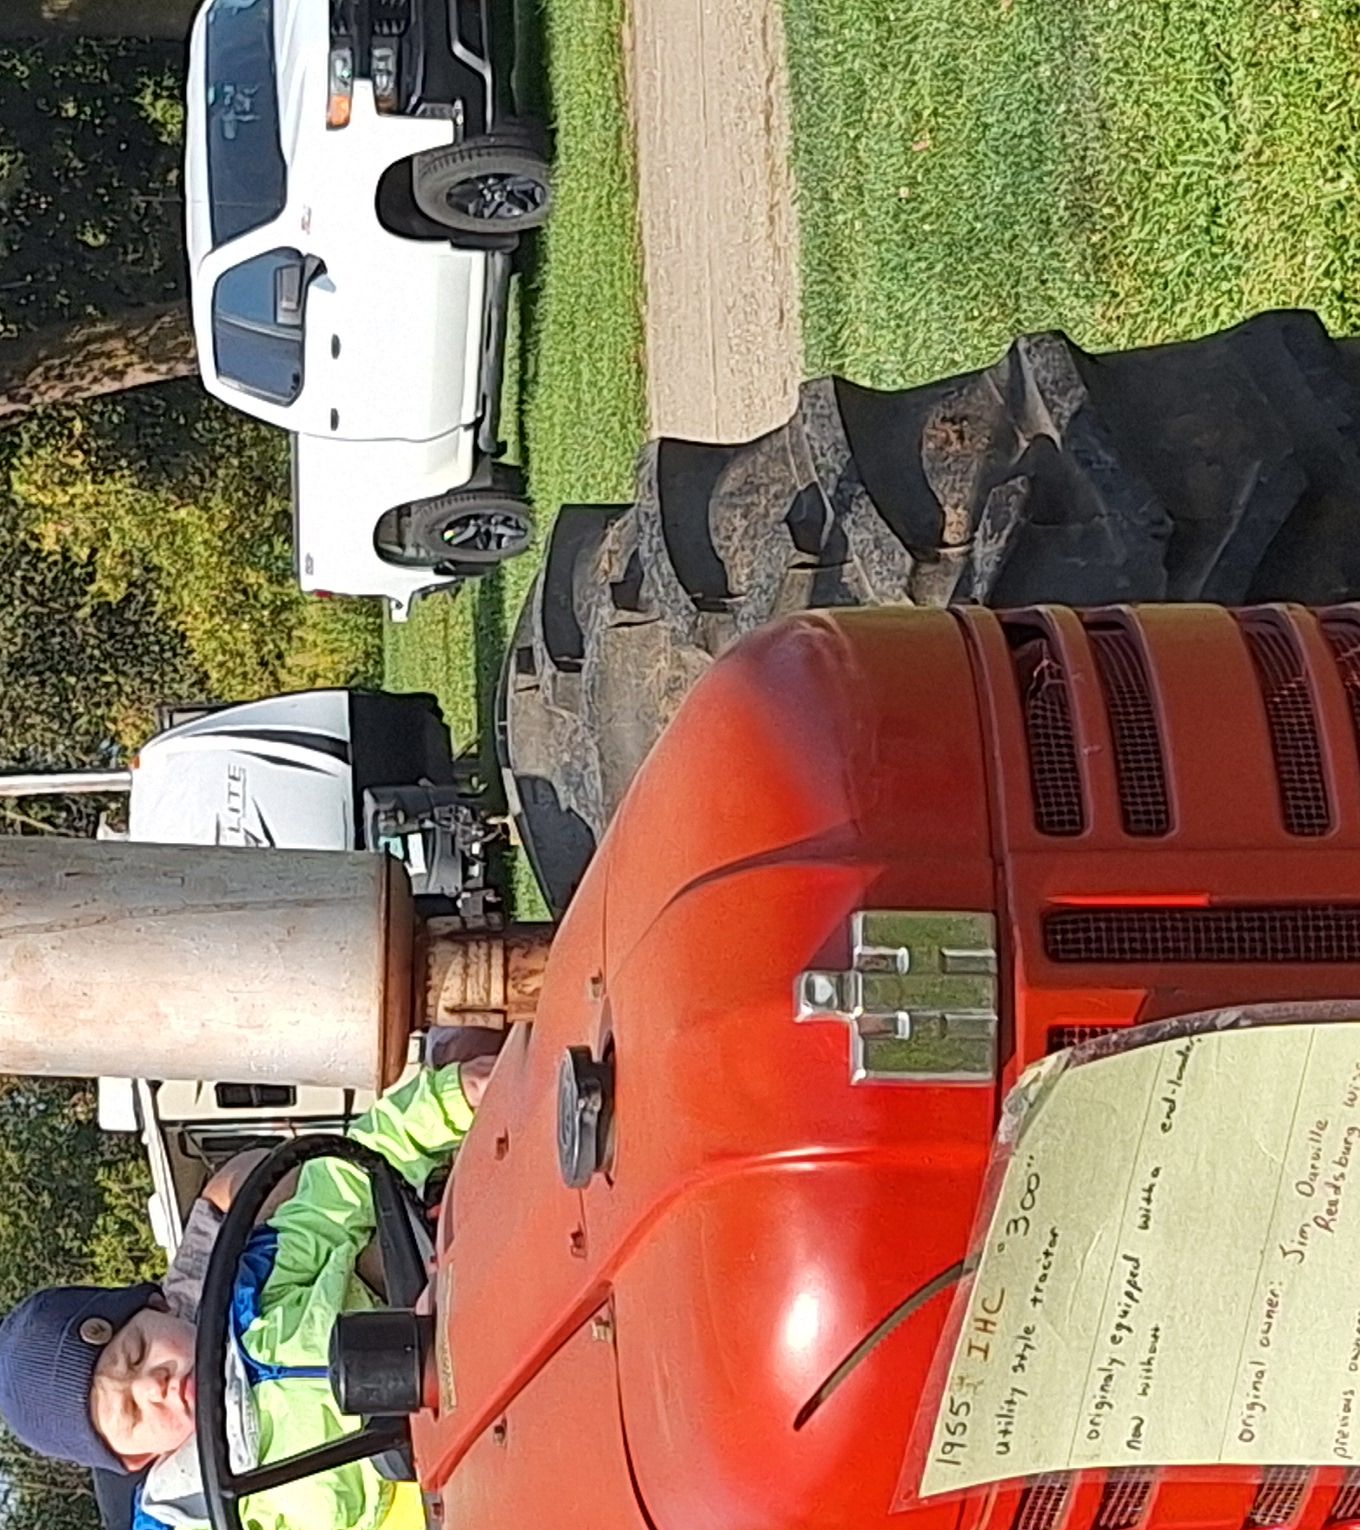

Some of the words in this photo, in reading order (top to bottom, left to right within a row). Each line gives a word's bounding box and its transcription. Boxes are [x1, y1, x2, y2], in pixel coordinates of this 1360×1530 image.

[227, 764, 241, 833] LITE
[966, 1287, 1005, 1362] IHC
[1011, 1324, 1036, 1373] style
[1029, 1227, 1059, 1308] tractor
[1109, 1254, 1142, 1345] equipped
[1258, 1280, 1283, 1347] owner:
[1278, 1223, 1311, 1264] Jim
[1137, 1325, 1161, 1397] without
